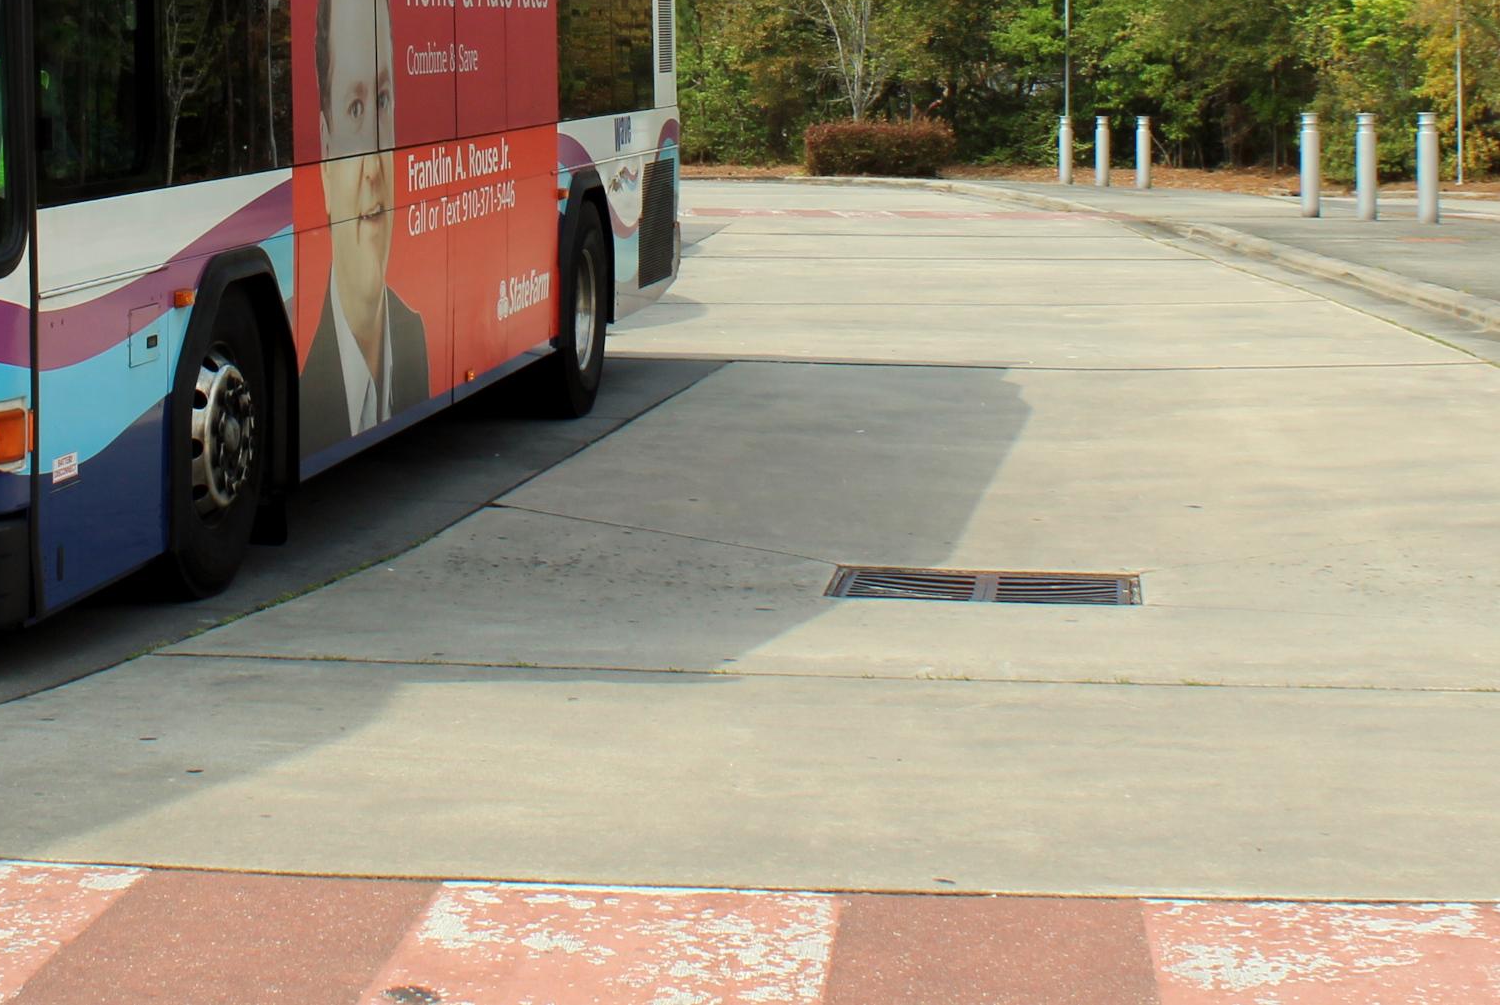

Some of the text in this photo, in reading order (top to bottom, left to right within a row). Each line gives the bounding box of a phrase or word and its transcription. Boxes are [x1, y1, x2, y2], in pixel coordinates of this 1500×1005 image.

[406, 42, 447, 75] Combine
[458, 44, 478, 73] Save
[408, 137, 511, 192] Franklin A. Rouse Jr.
[408, 180, 516, 236] Call or Text 910-371-5446
